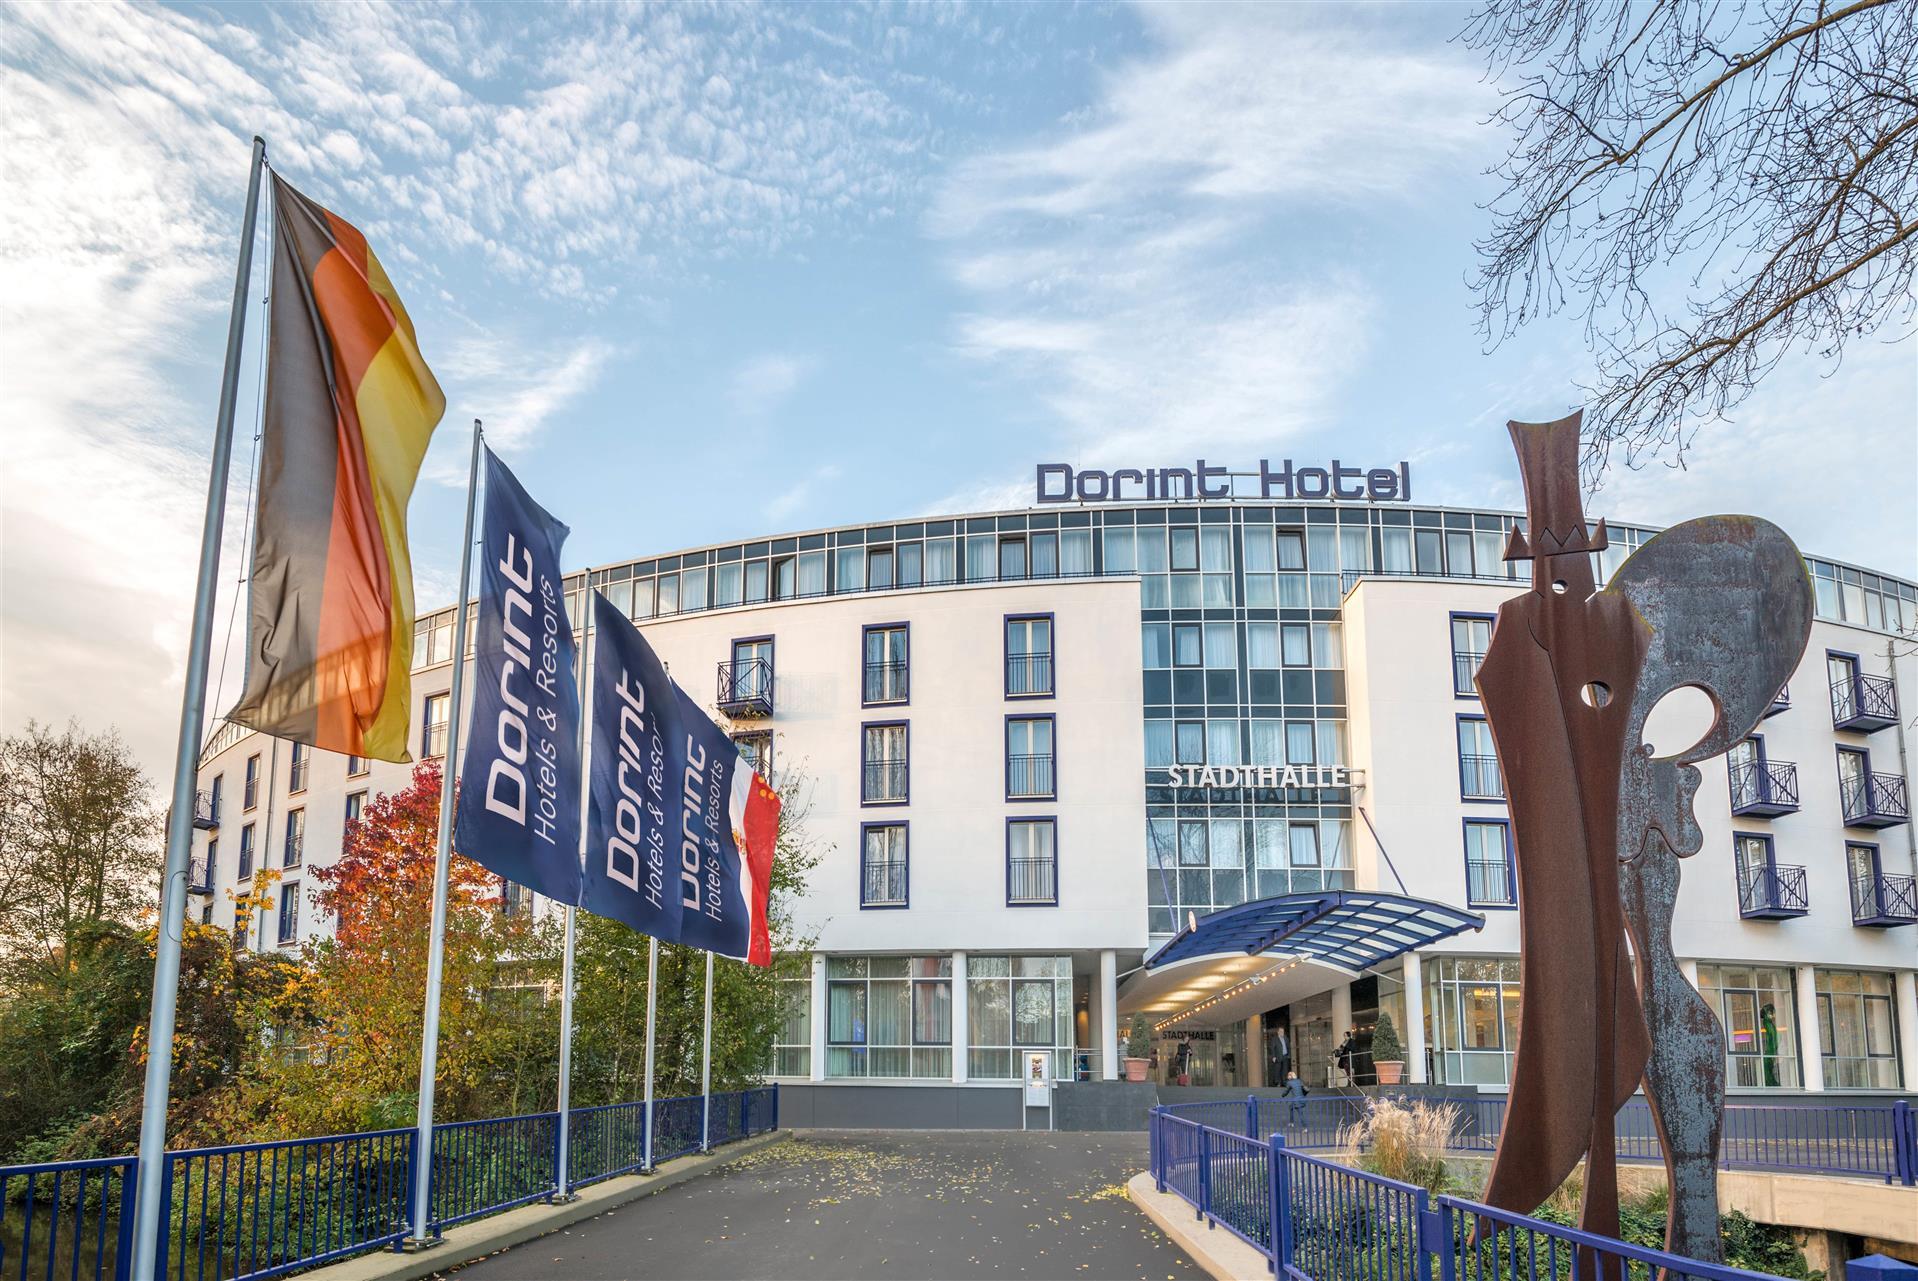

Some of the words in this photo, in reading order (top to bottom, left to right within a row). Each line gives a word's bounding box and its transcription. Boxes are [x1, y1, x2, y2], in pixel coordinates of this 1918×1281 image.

[1036, 459, 1230, 502] Dorint
[1260, 458, 1411, 502] Hotel
[535, 574, 558, 698] Resorts
[485, 532, 533, 827] Dorint
[536, 707, 557, 732] &
[647, 711, 665, 802] Resor
[533, 738, 557, 846] Hotels
[606, 666, 645, 893] Dorint
[704, 759, 724, 835] Resorts
[1168, 764, 1347, 788] STADTHALLE
[647, 803, 664, 827] &
[704, 835, 720, 855] &
[645, 828, 664, 911] Hotels
[705, 856, 723, 922] Hotels
